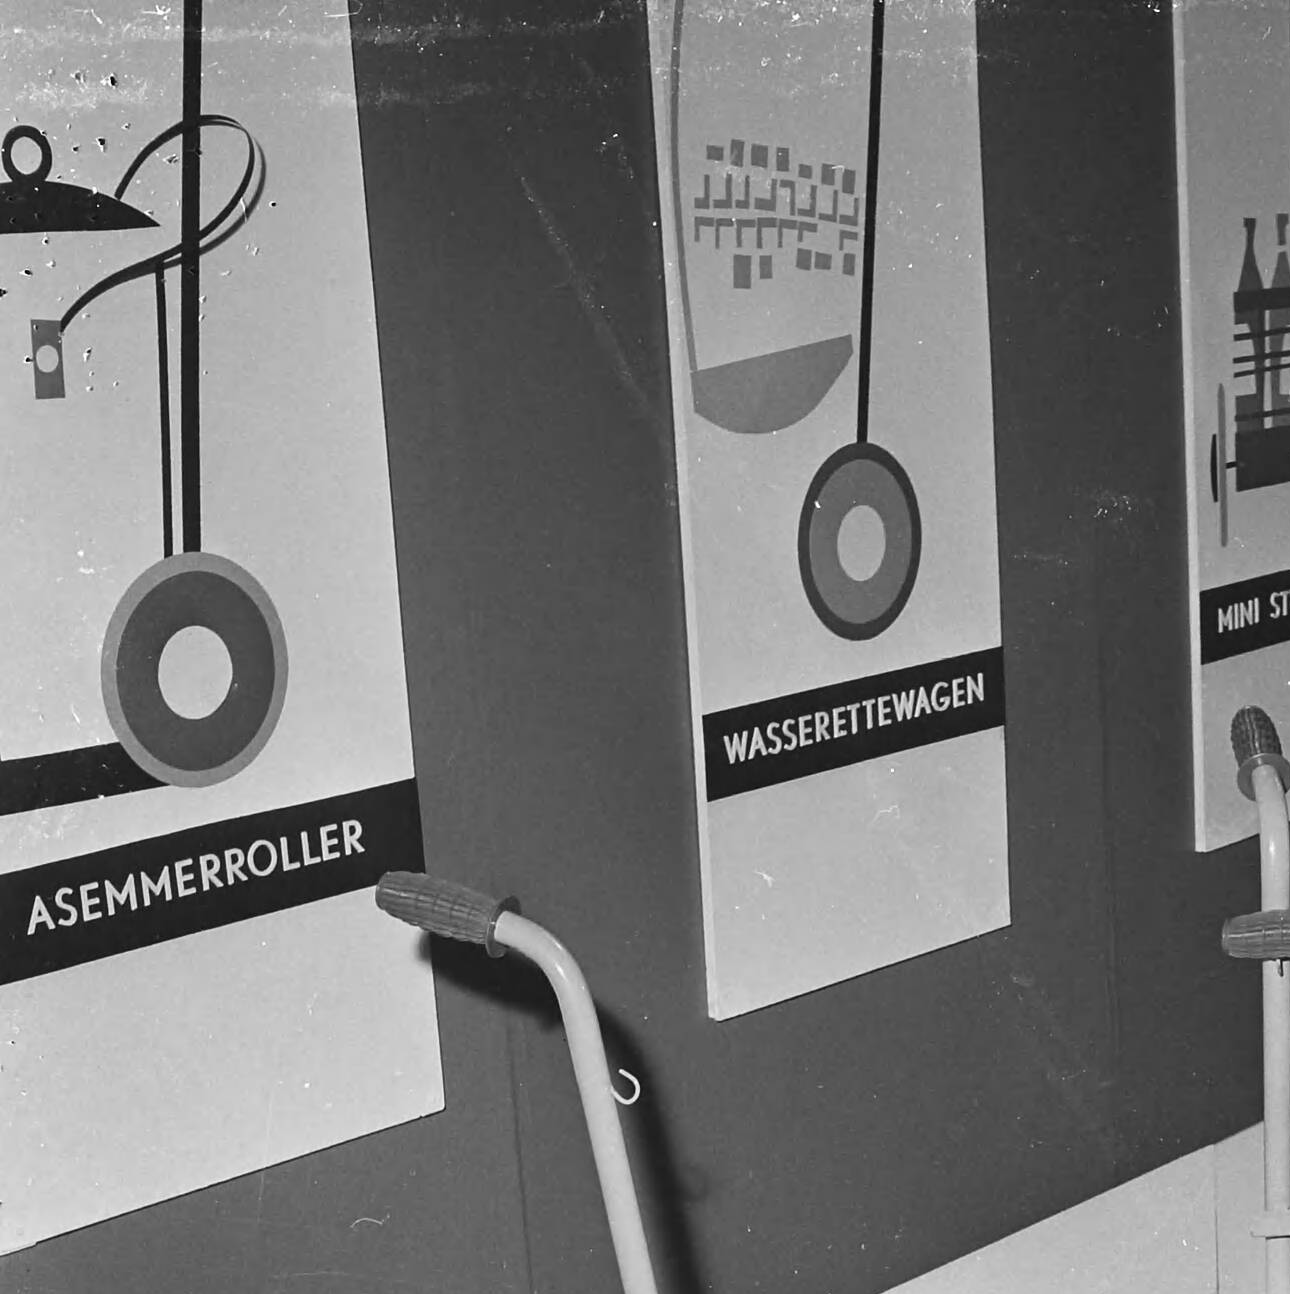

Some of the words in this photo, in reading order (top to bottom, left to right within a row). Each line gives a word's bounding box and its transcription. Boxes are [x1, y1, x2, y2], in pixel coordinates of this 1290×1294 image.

[1218, 598, 1260, 634] MINI
[723, 672, 985, 765] WASSERETTEWAGEN
[27, 819, 366, 936] ASEMMERROLLER
